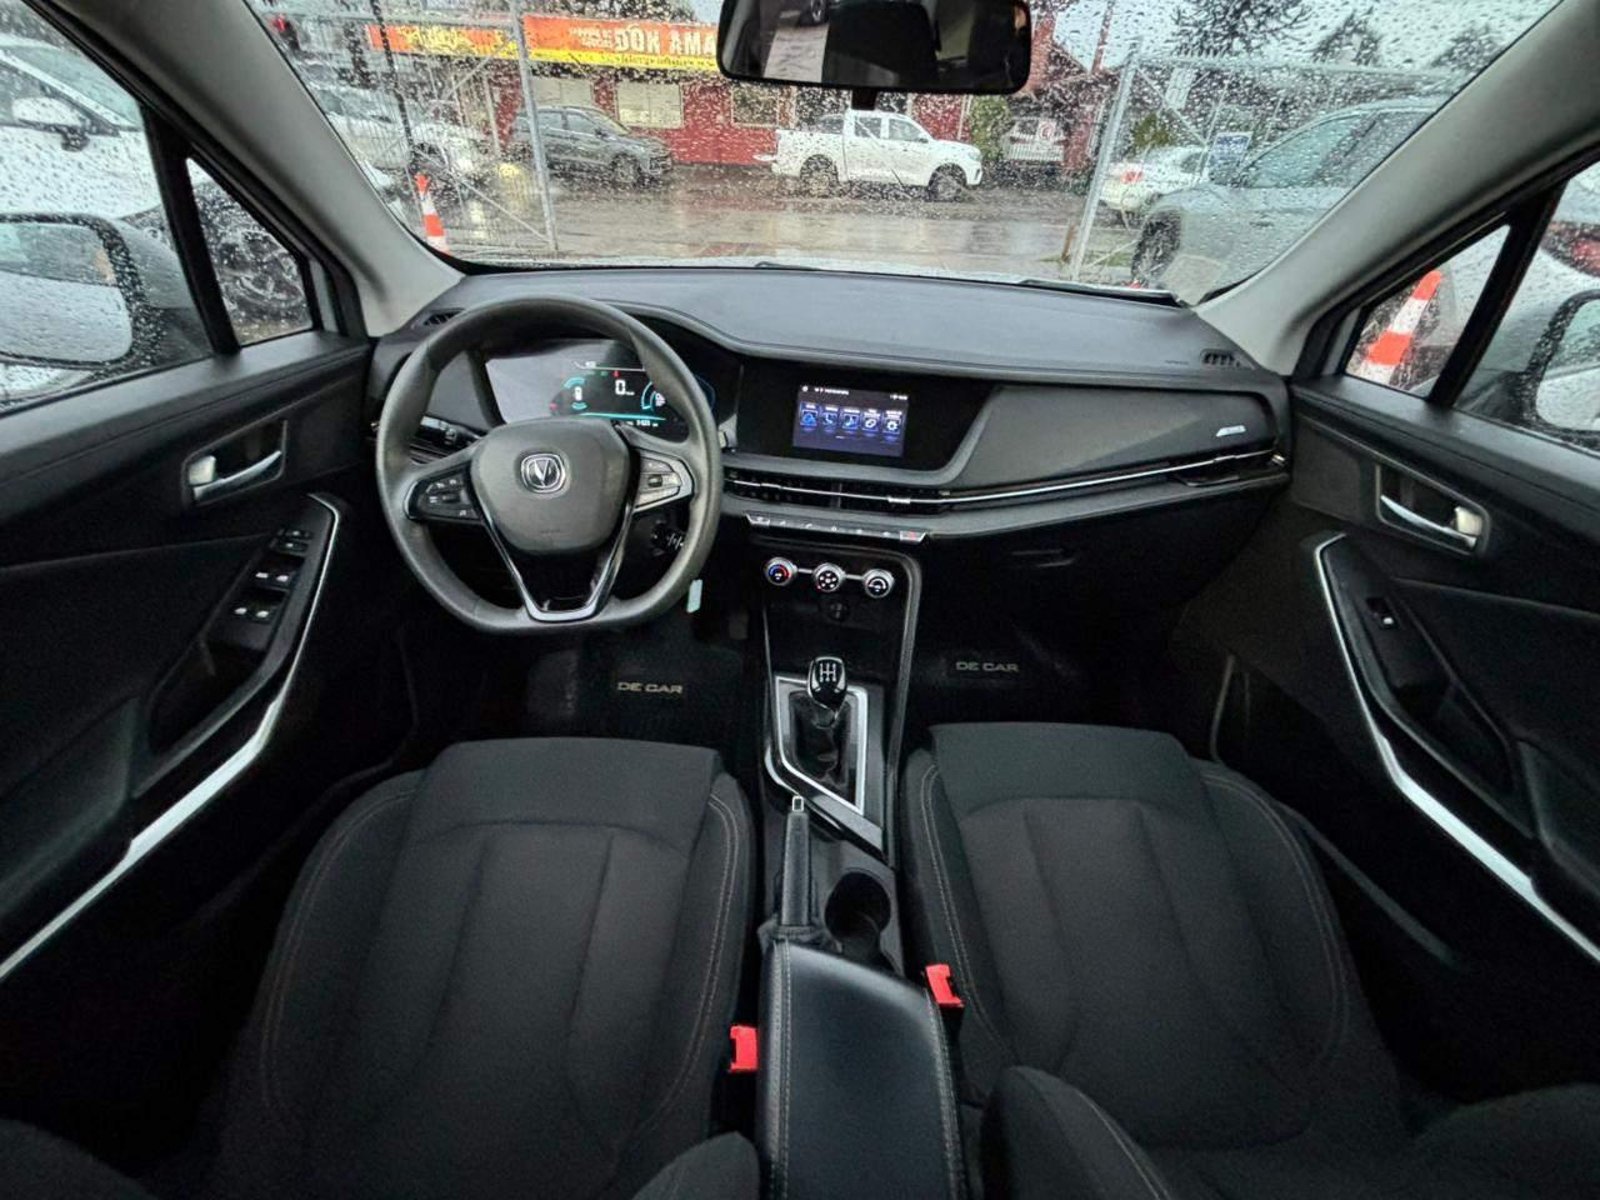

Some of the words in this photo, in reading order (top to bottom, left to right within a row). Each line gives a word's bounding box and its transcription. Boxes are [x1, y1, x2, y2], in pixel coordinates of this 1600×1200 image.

[614, 379, 626, 395] 0
[956, 661, 979, 671] DE
[982, 662, 1019, 673] CAR
[617, 681, 642, 692] DE
[645, 683, 683, 694] CAR
